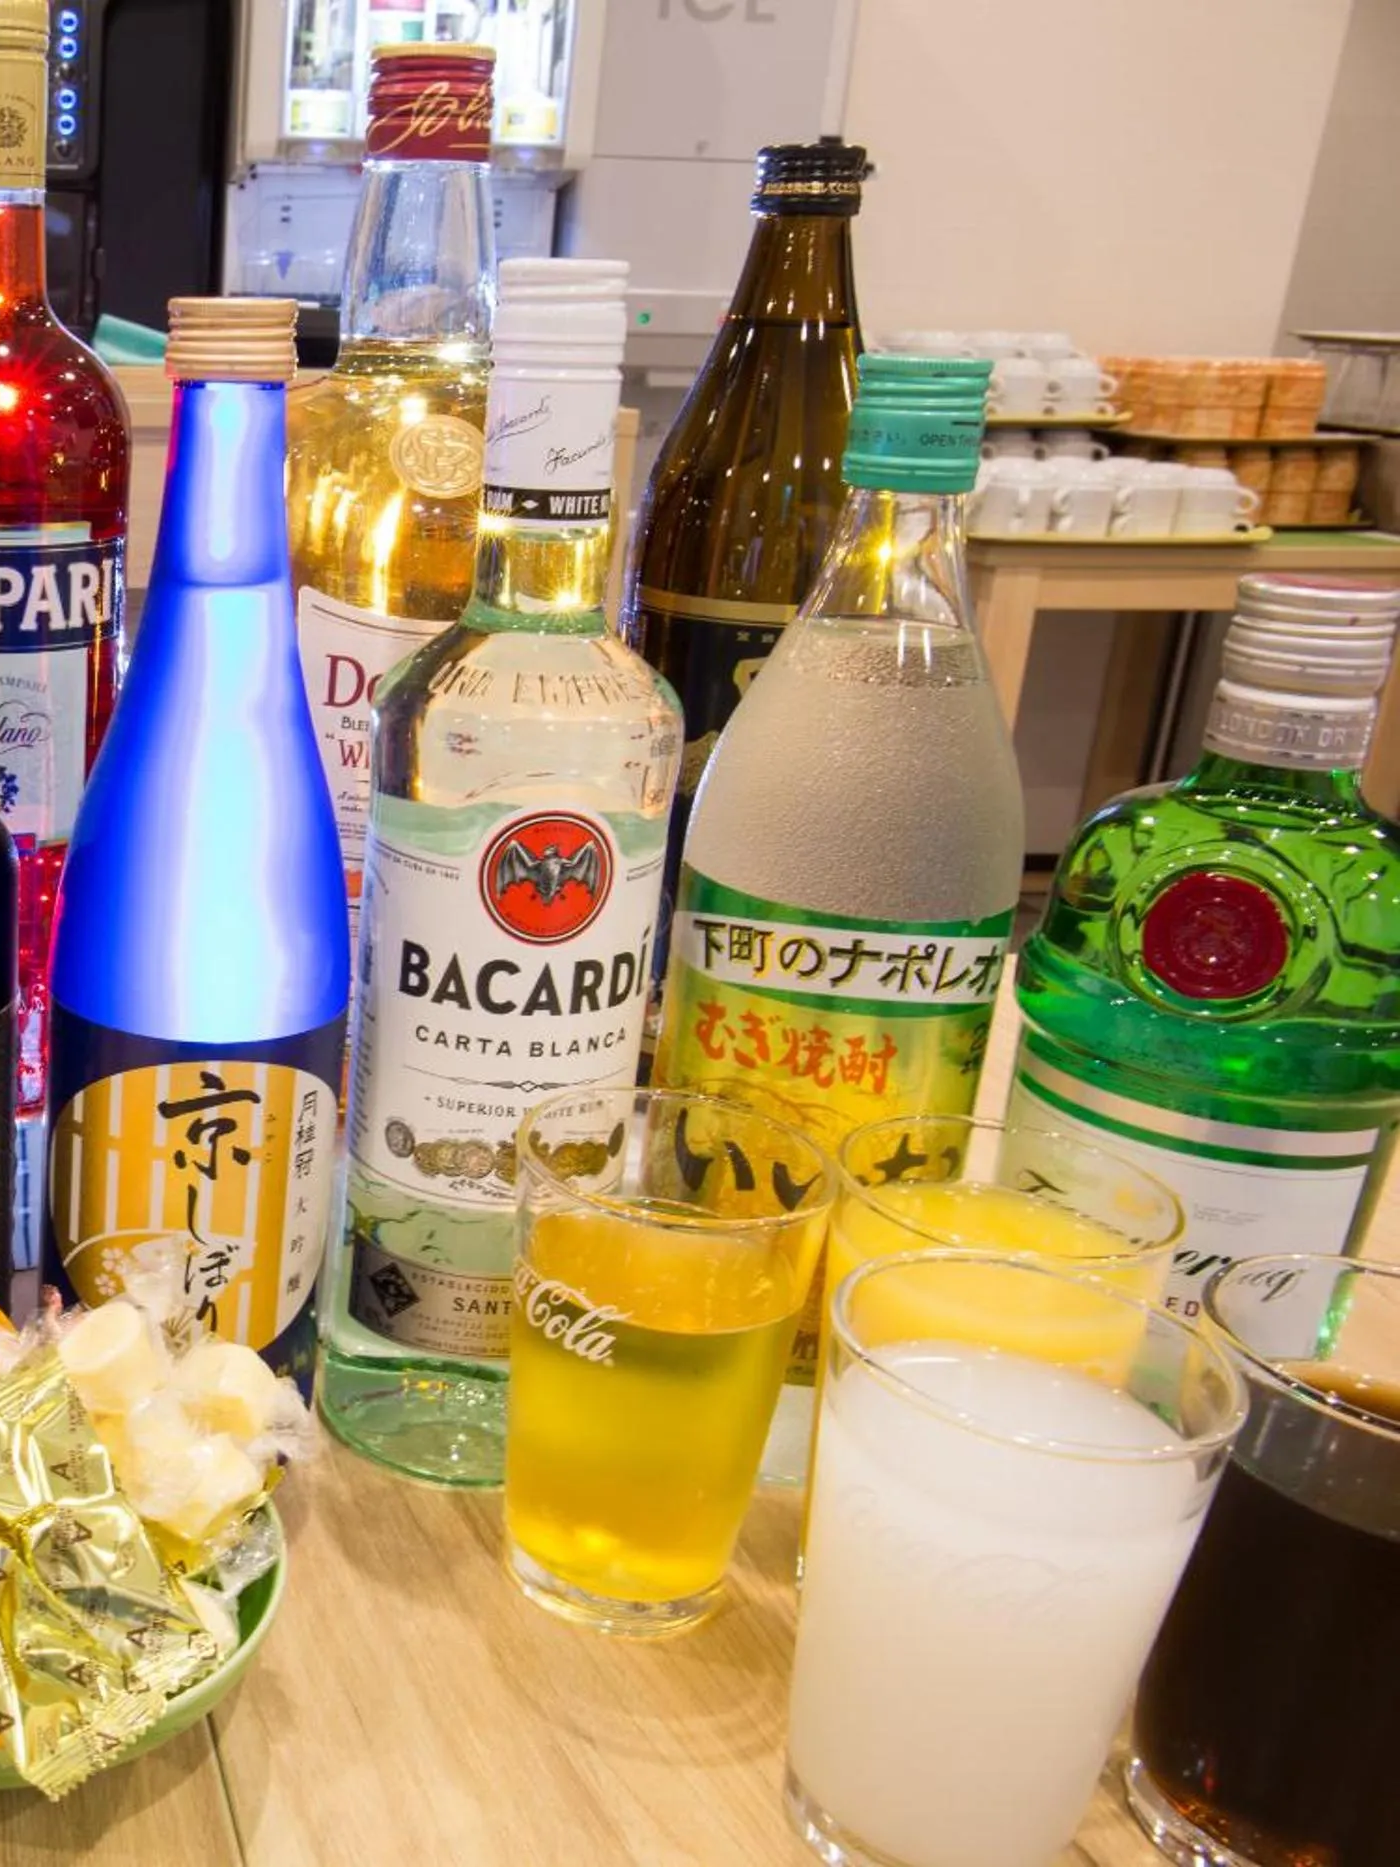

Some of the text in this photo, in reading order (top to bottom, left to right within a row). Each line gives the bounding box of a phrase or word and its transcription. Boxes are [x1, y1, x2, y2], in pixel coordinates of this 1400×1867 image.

[548, 495, 600, 515] WHITE
[415, 1024, 627, 1058] CARTA BLANCA
[695, 998, 898, 1095] むぎ焼酎
[436, 1095, 517, 1118] SUPERIOR
